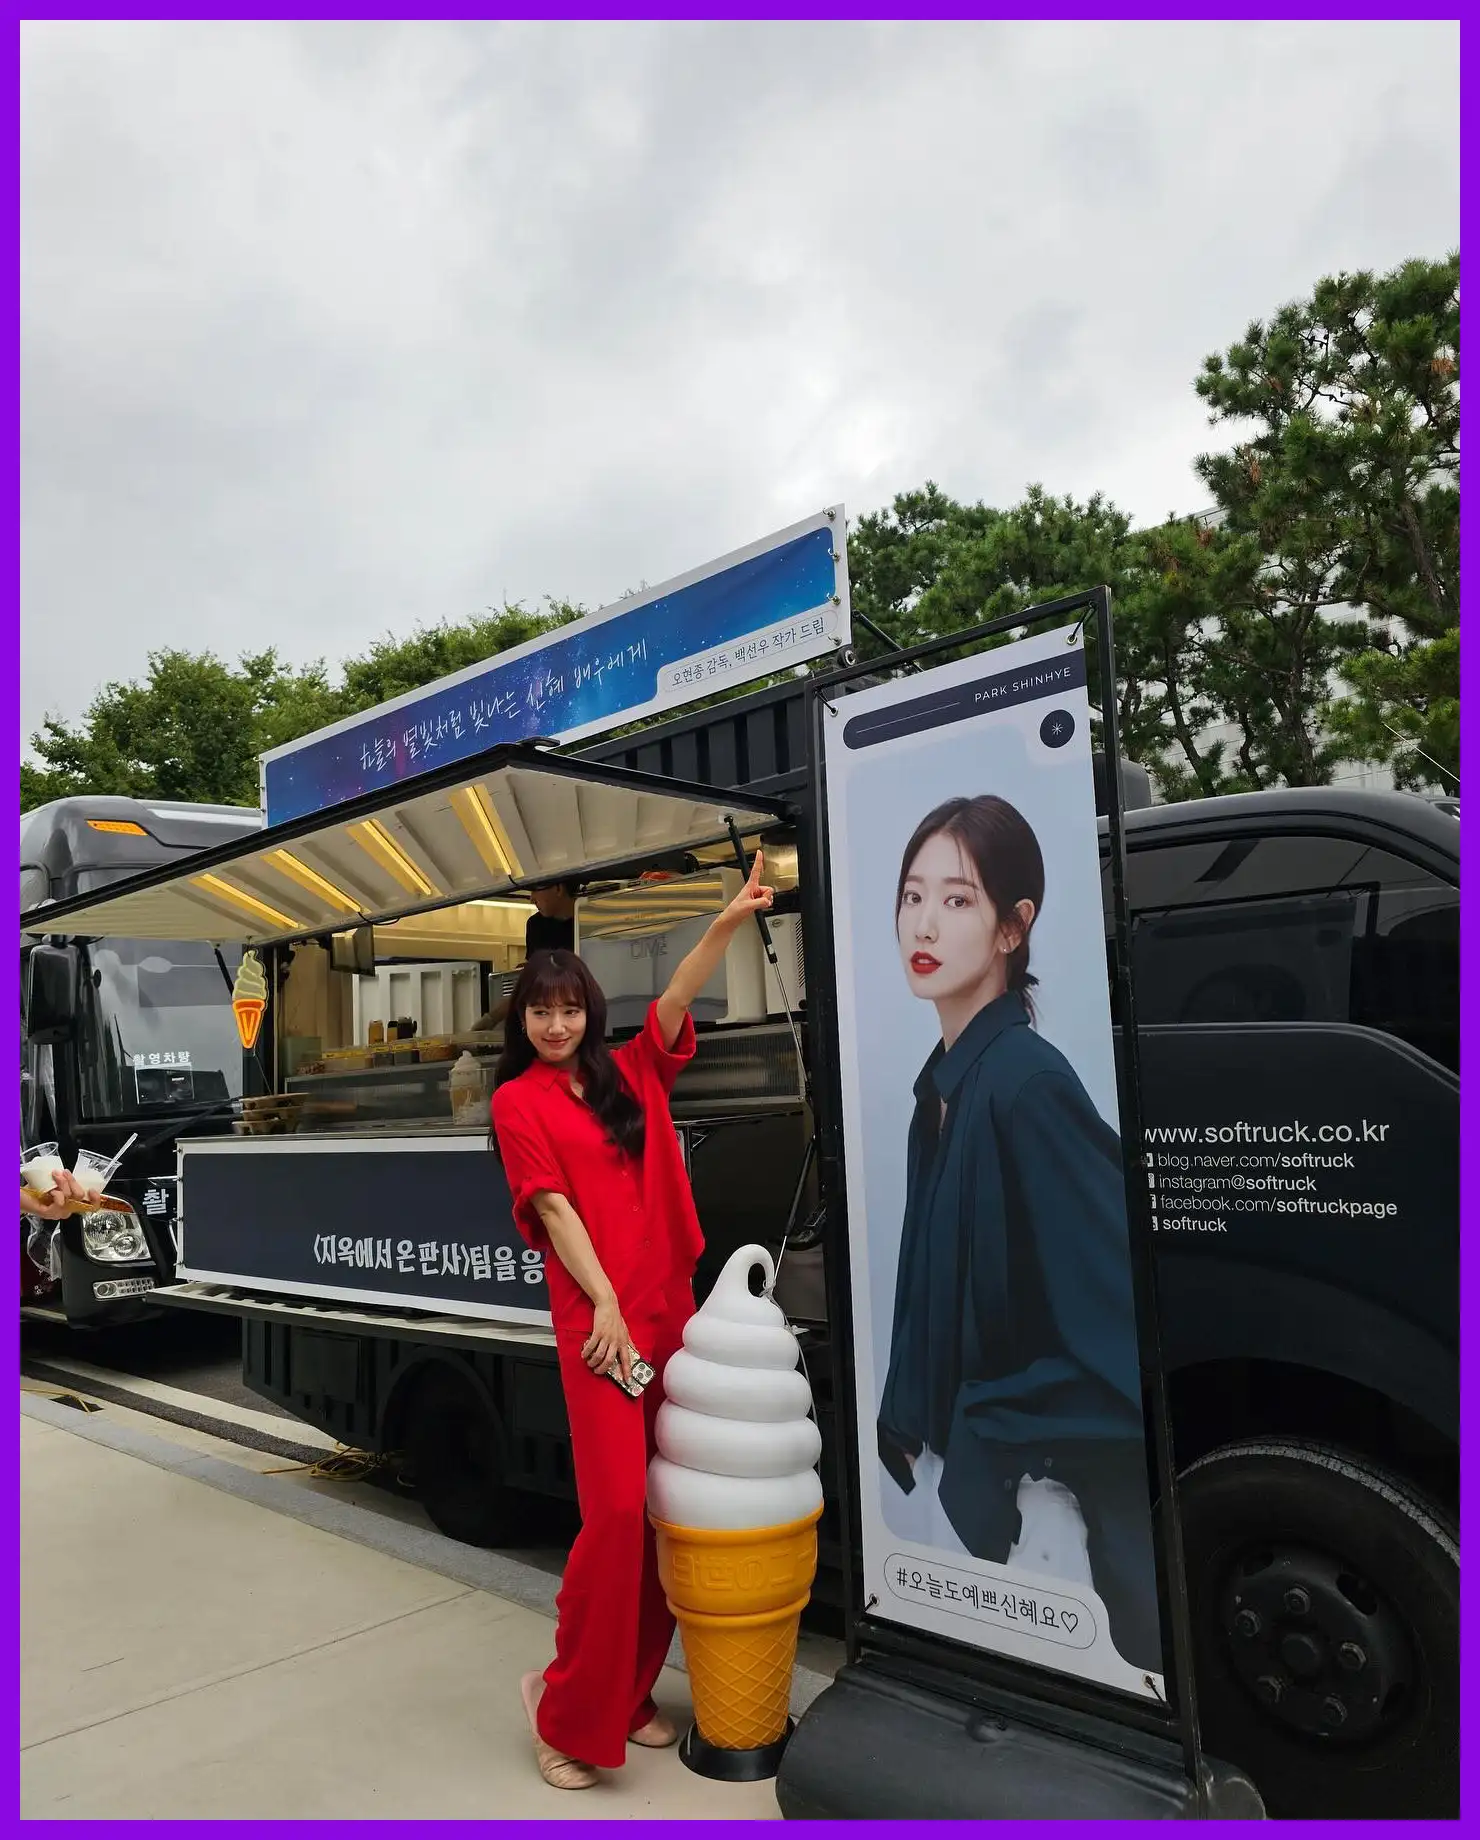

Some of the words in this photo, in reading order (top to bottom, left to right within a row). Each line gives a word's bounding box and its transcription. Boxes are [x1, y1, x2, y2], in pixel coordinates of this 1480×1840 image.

[671, 662, 705, 687] 오현종
[706, 653, 732, 675] 감독,
[734, 641, 770, 664] 백선우
[772, 627, 797, 650] 작가
[800, 616, 825, 639] 드림
[974, 686, 1008, 703] PARK
[1012, 666, 1072, 692] SHINHYE
[360, 737, 397, 772] 하늘의
[403, 709, 467, 760] 별빛처럼
[469, 691, 522, 734] 빛나는
[526, 668, 564, 711] 신혜
[573, 638, 647, 689] 배우에게
[1157, 1152, 1355, 1170] blog.naver.com/softruck
[1158, 1174, 1317, 1192] instagram@softruck
[142, 1188, 170, 1215] 촬
[1160, 1195, 1398, 1219] facebook.com/softruckpage
[1162, 1215, 1228, 1233] softruck
